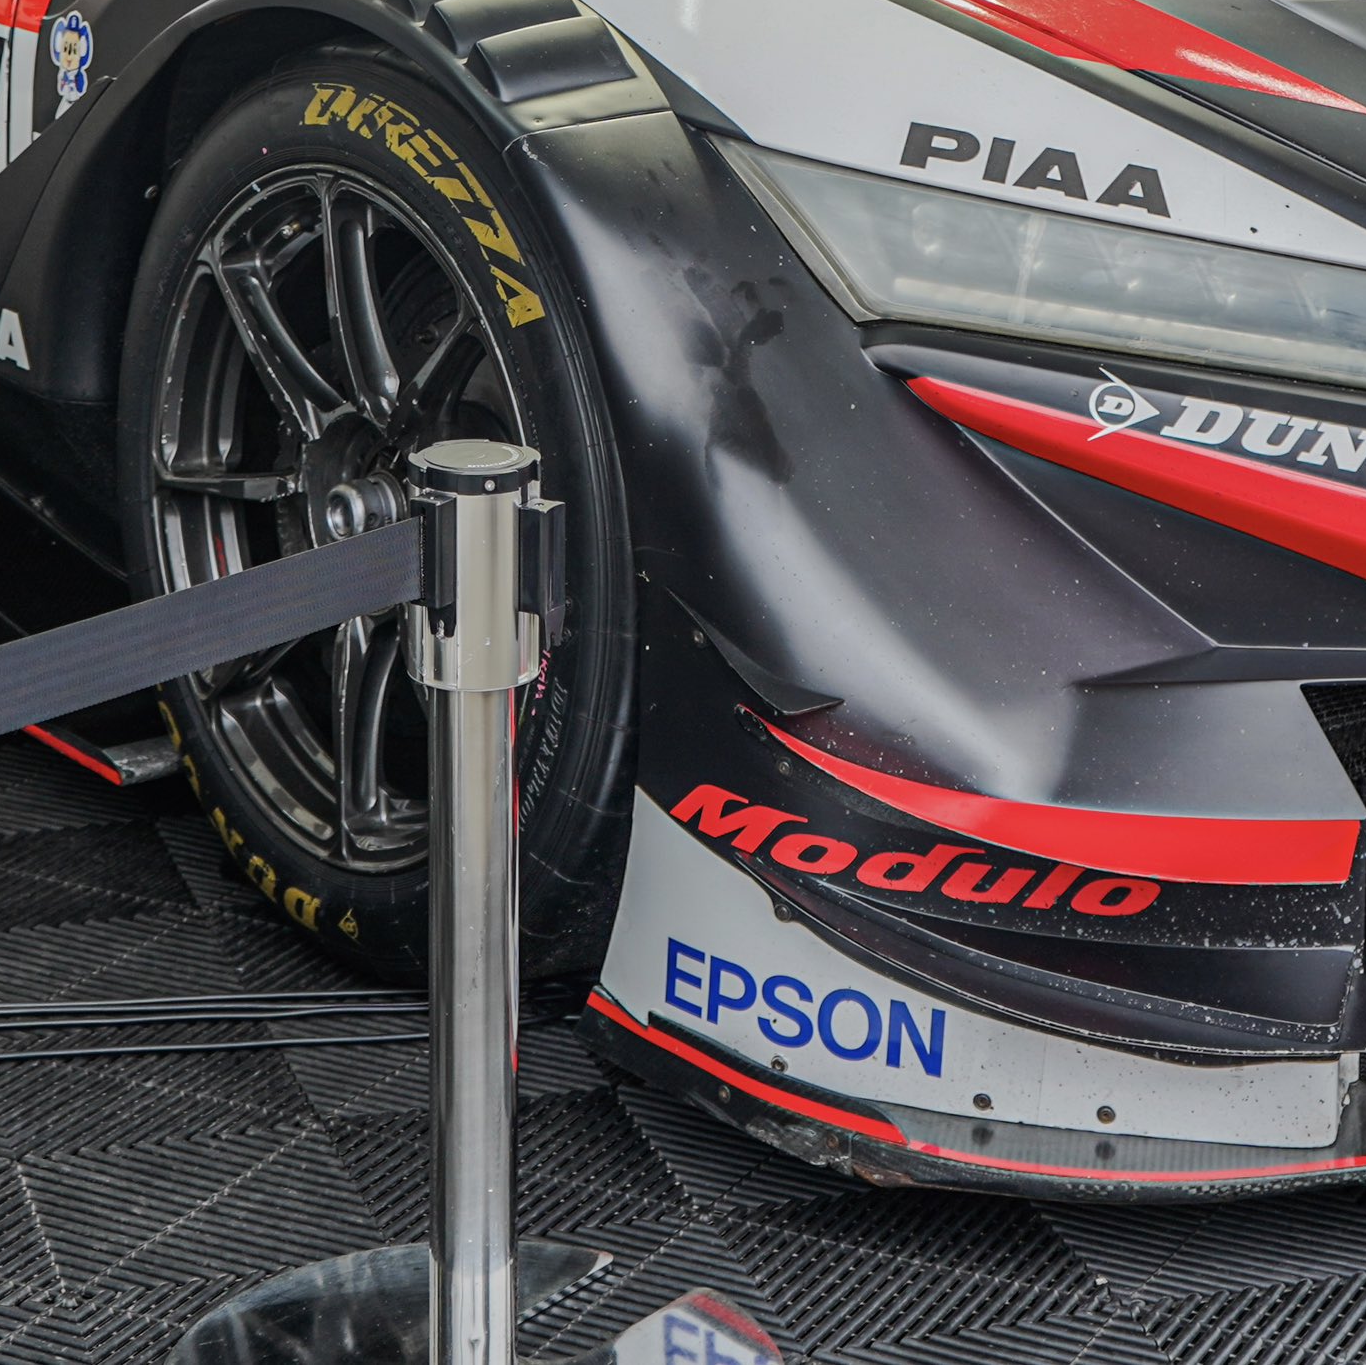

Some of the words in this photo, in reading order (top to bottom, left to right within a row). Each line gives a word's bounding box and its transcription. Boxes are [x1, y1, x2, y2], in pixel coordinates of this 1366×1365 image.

[298, 81, 546, 329] DIREZZA
[899, 121, 1171, 219] PIAA
[669, 783, 1162, 917] Modulo
[664, 936, 947, 1079] EPSON
